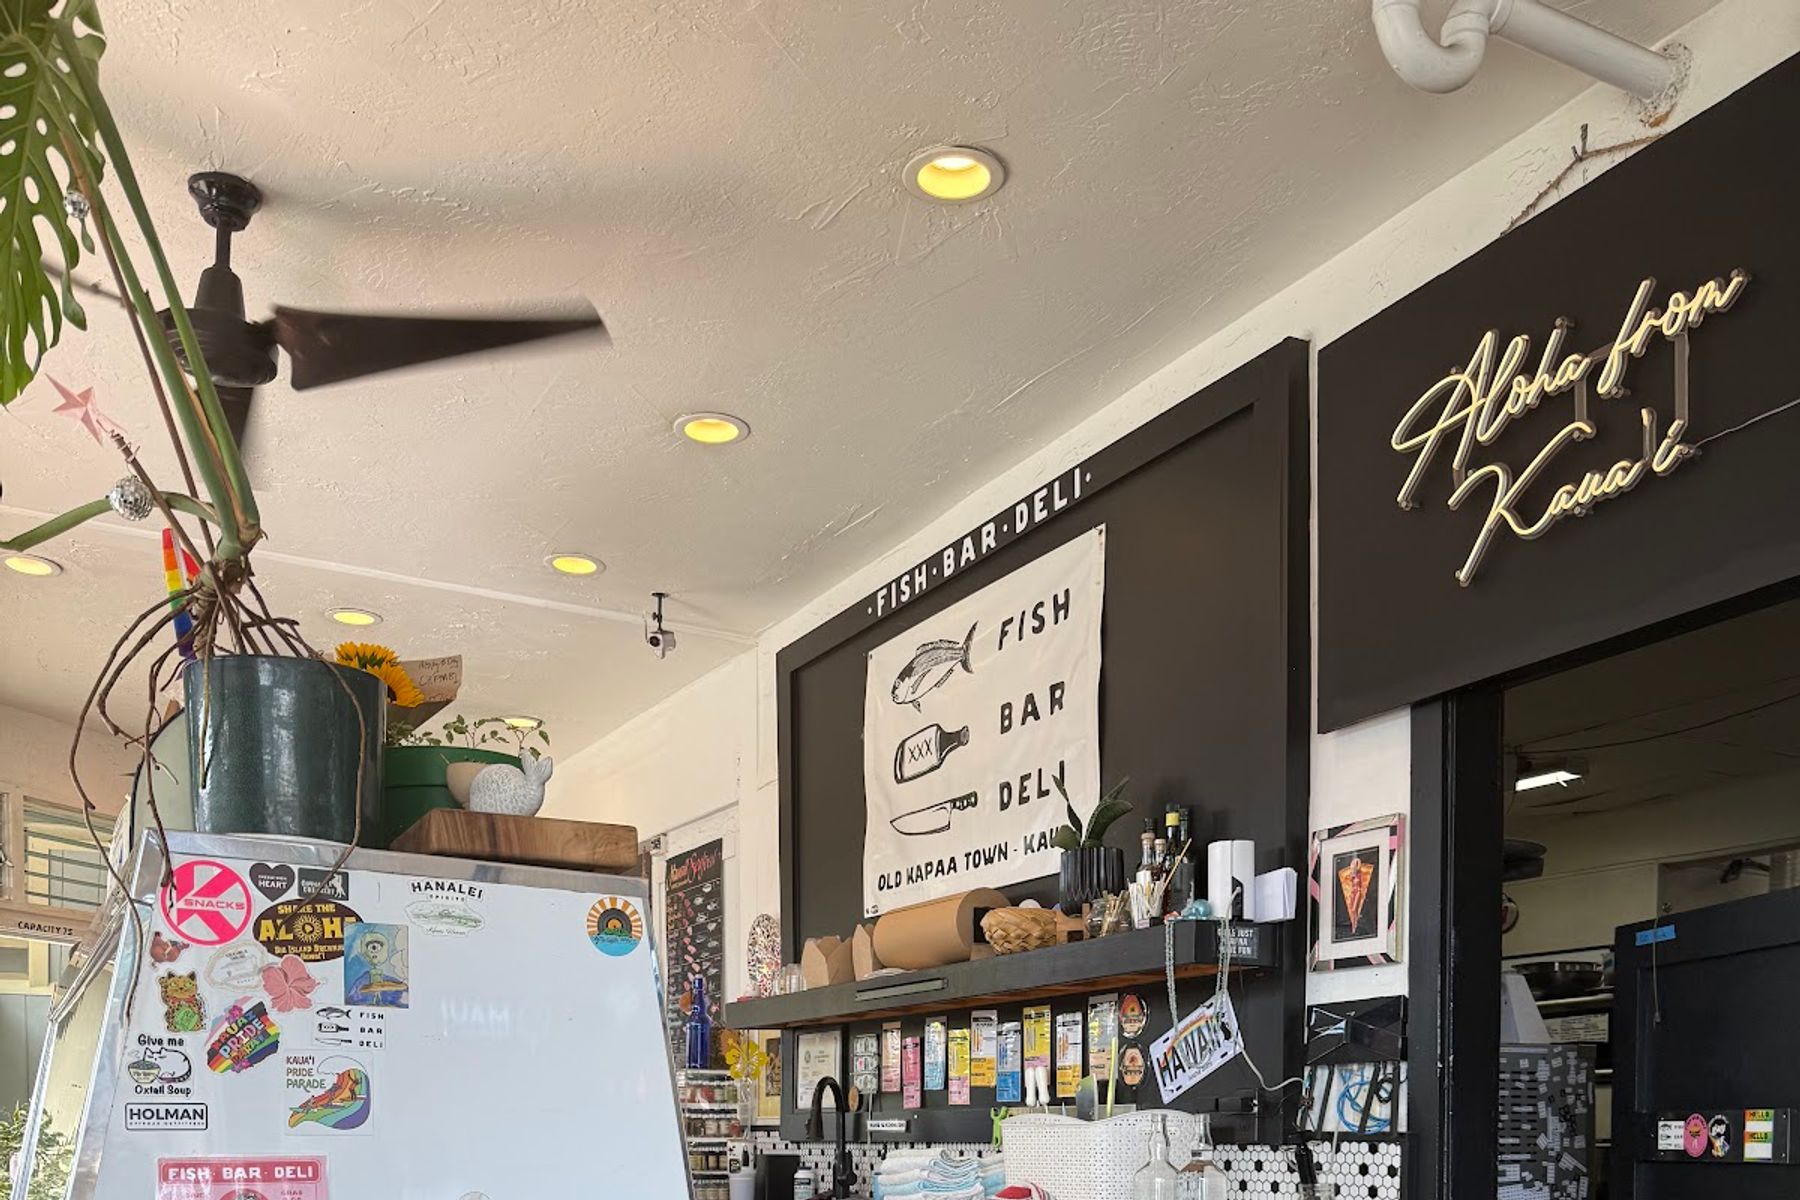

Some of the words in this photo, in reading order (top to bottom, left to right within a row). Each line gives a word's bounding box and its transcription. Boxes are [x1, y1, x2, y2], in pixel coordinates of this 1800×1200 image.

[1391, 328, 1592, 508] Aloha
[1597, 274, 1749, 396] from
[876, 563, 928, 617] FISH
[942, 522, 997, 578] BAR
[1014, 467, 1082, 534] DELI
[998, 588, 1071, 650] FISH
[1000, 681, 1066, 735] BAR
[907, 736, 933, 764] XXX
[999, 760, 1067, 812] DELI
[877, 870, 902, 892] OLD
[906, 856, 958, 886] KAPAA
[964, 842, 1008, 872] TOWN
[1024, 826, 1059, 855] KAU
[257, 880, 288, 889] HEART
[411, 880, 483, 899] HANALEI
[183, 898, 245, 911] SNACKS
[315, 903, 336, 914] THE
[17, 920, 62, 934] CAPACITY
[360, 1012, 384, 1020] FISH
[167, 1037, 184, 1047] me
[219, 1017, 264, 1058] PRIDE
[359, 1040, 384, 1048] DELI
[286, 1068, 314, 1077] PRIDE
[166, 1084, 192, 1098] Soup
[286, 1079, 327, 1093] PARADE
[129, 1108, 205, 1121] HOLMAN
[168, 1167, 210, 1180] FISH
[222, 1166, 261, 1179] BAR
[274, 1165, 313, 1178] DELI
